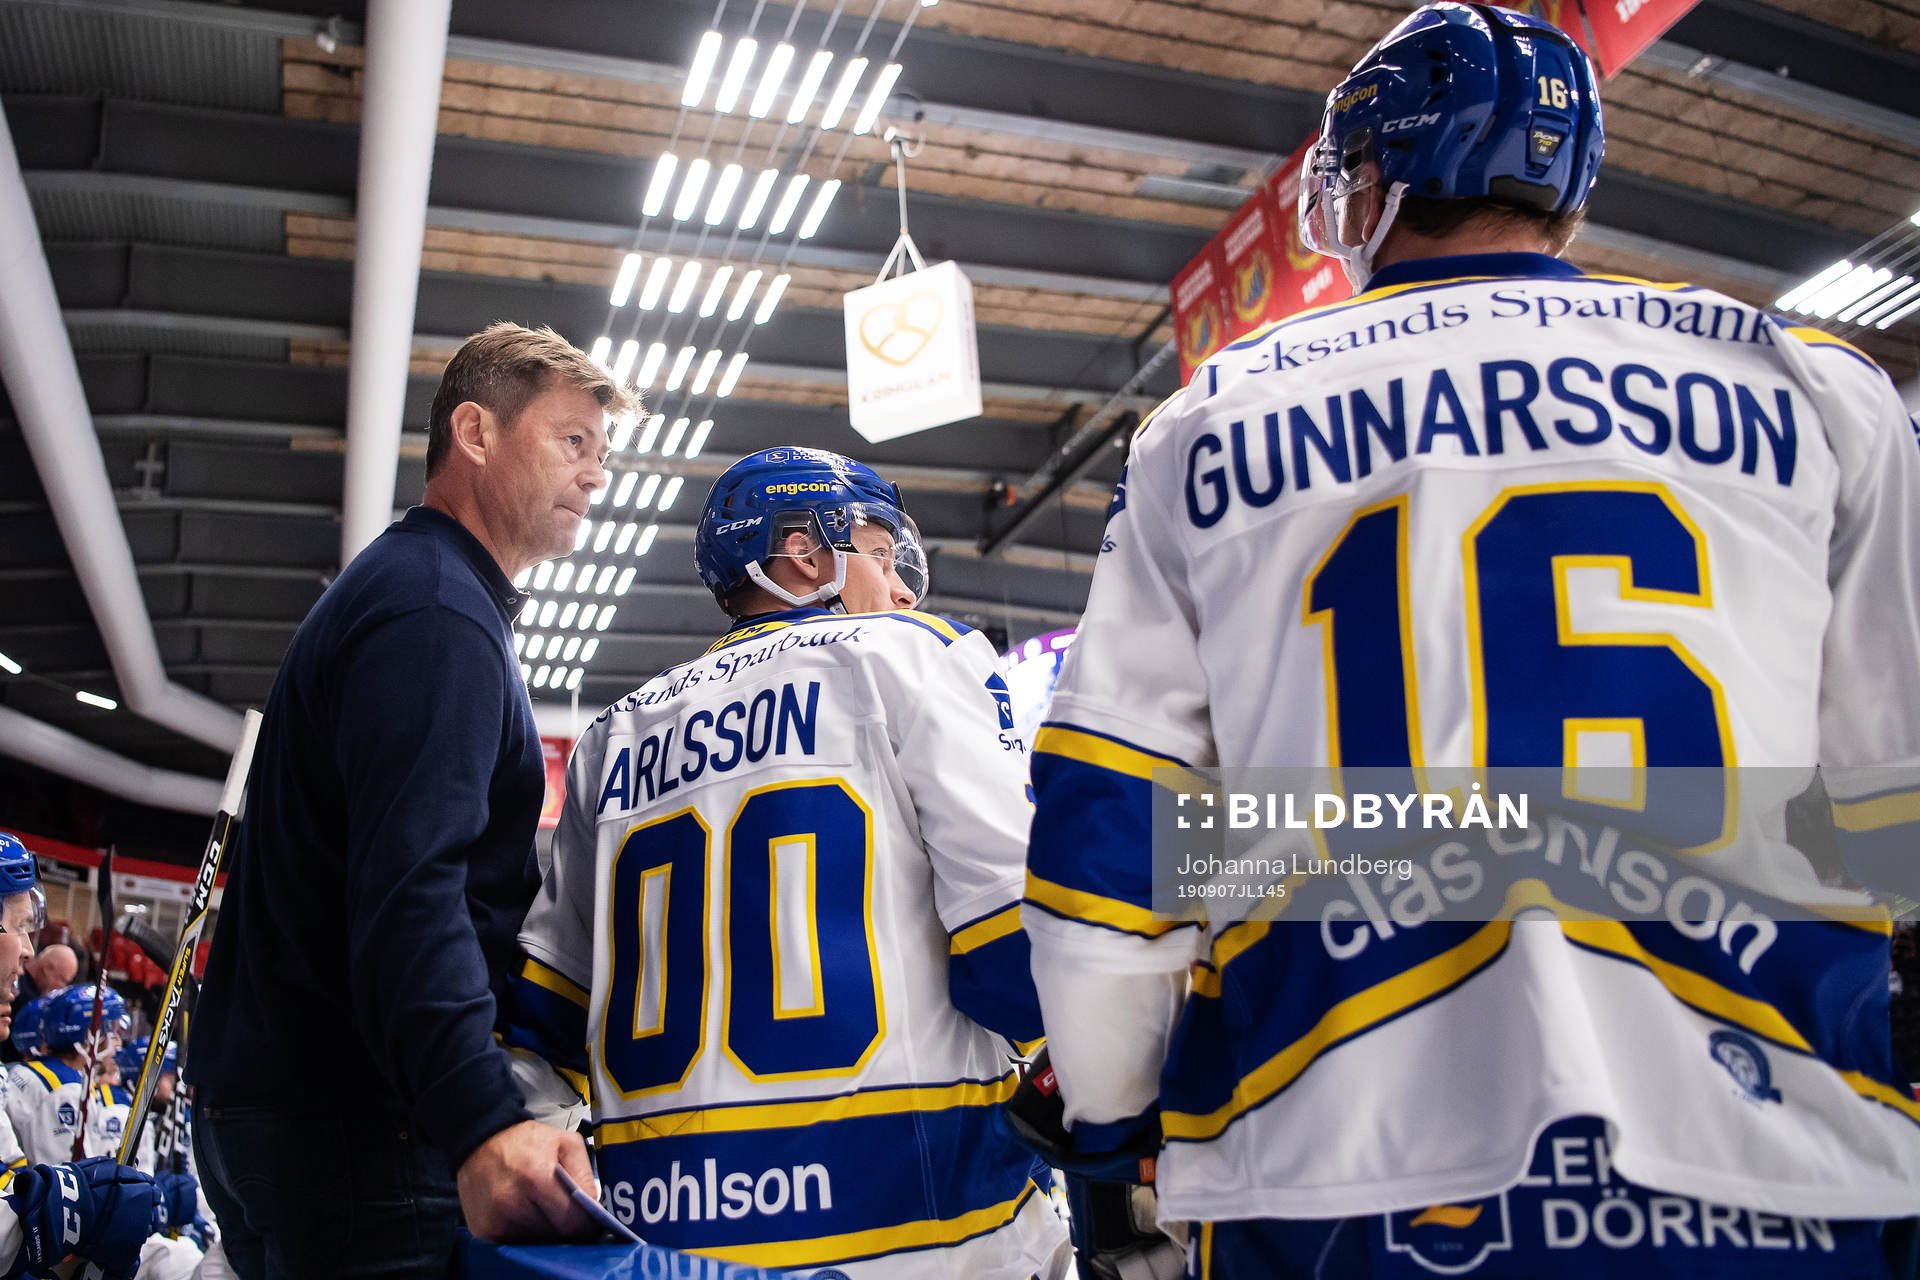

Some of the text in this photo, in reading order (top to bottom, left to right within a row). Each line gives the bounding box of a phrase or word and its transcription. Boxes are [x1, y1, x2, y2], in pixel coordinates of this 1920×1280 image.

[1382, 112, 1441, 133] CCM
[1537, 75, 1568, 109] 16
[1489, 288, 1776, 346] Sparbank
[1184, 356, 1797, 530] GUNNARSSON
[765, 482, 830, 495] engcon
[715, 516, 764, 535] CCM
[1301, 479, 1739, 858] 16
[196, 840, 222, 910] CCM
[1320, 841, 1483, 960] clas
[177, 946, 192, 986] SUPER
[601, 777, 887, 1101] 00
[158, 984, 182, 1047] TACKS
[640, 1157, 833, 1225] ohlson
[1542, 1187, 1836, 1252] DÖRREN
